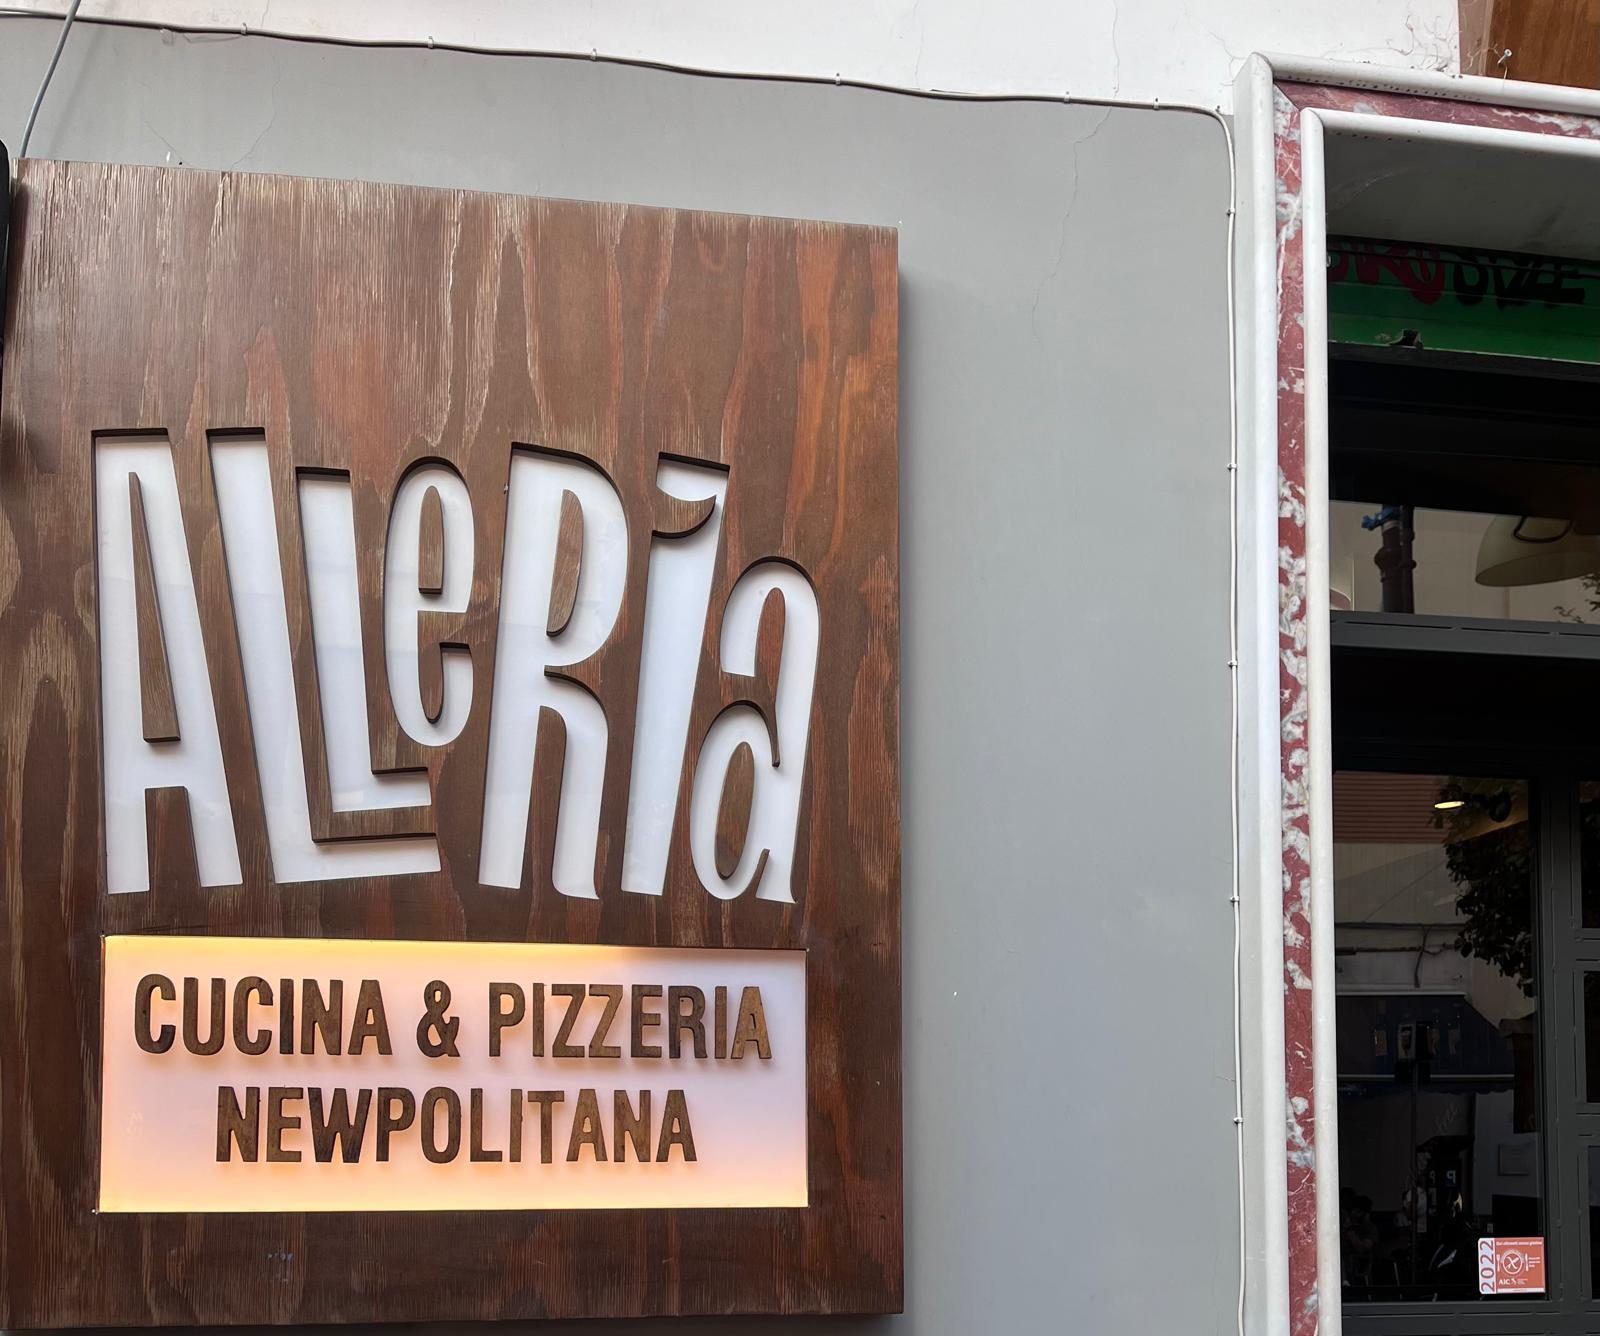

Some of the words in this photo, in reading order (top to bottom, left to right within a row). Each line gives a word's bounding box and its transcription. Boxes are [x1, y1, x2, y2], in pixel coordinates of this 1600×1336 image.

[133, 974, 393, 1056] CUCINA
[416, 979, 461, 1059] &
[488, 982, 773, 1060] PIZZERIA
[215, 1086, 698, 1163] NEWPOLITANA
[1479, 1240, 1495, 1293] 2022
